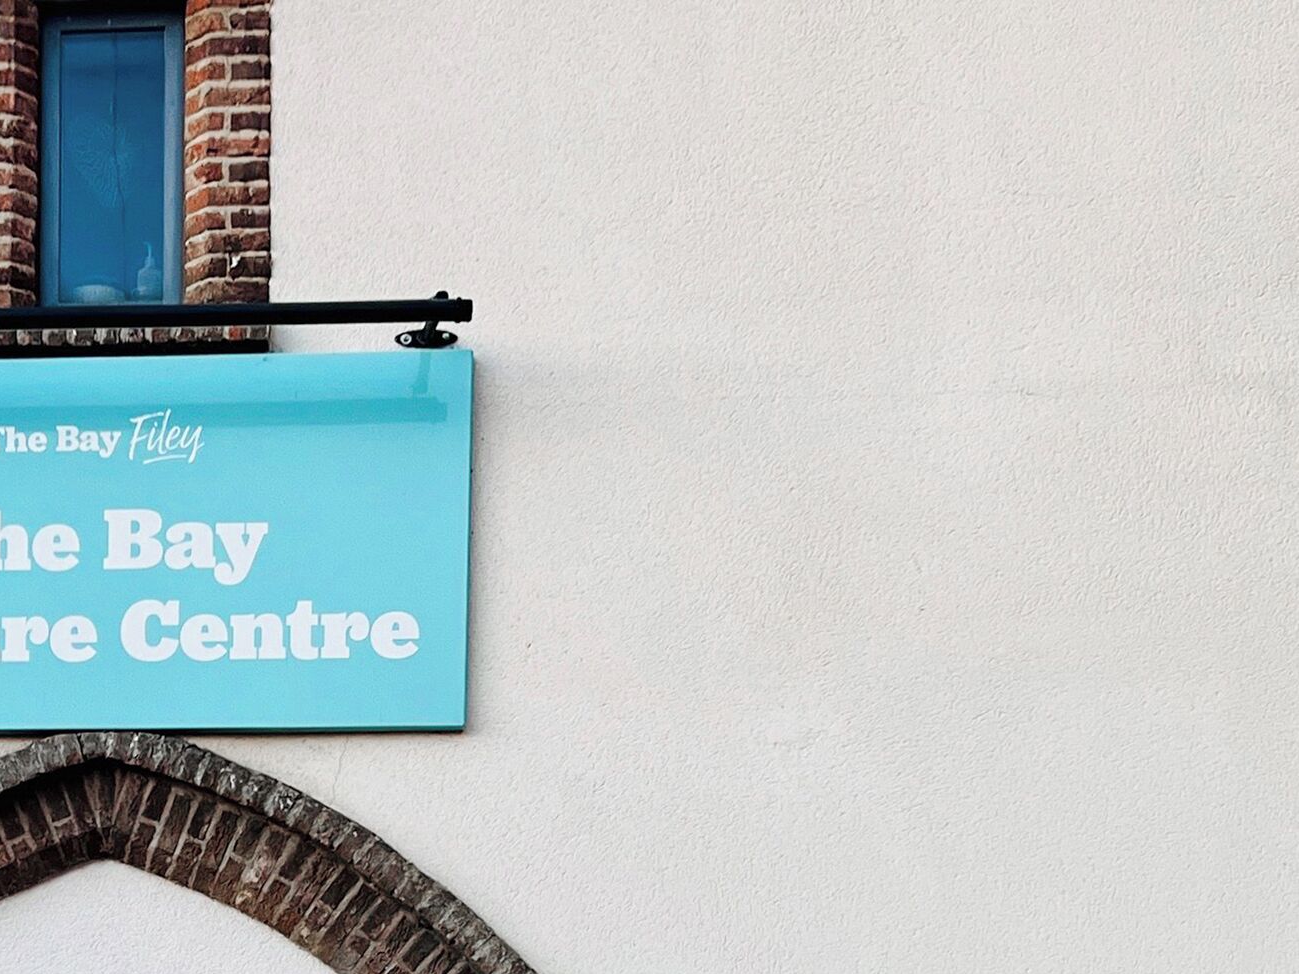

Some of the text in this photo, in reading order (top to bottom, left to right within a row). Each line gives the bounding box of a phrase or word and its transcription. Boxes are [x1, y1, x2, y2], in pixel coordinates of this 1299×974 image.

[55, 425, 121, 459] Bay
[128, 409, 205, 464] Filey
[103, 508, 269, 585] Bay
[120, 600, 420, 662] Centre
